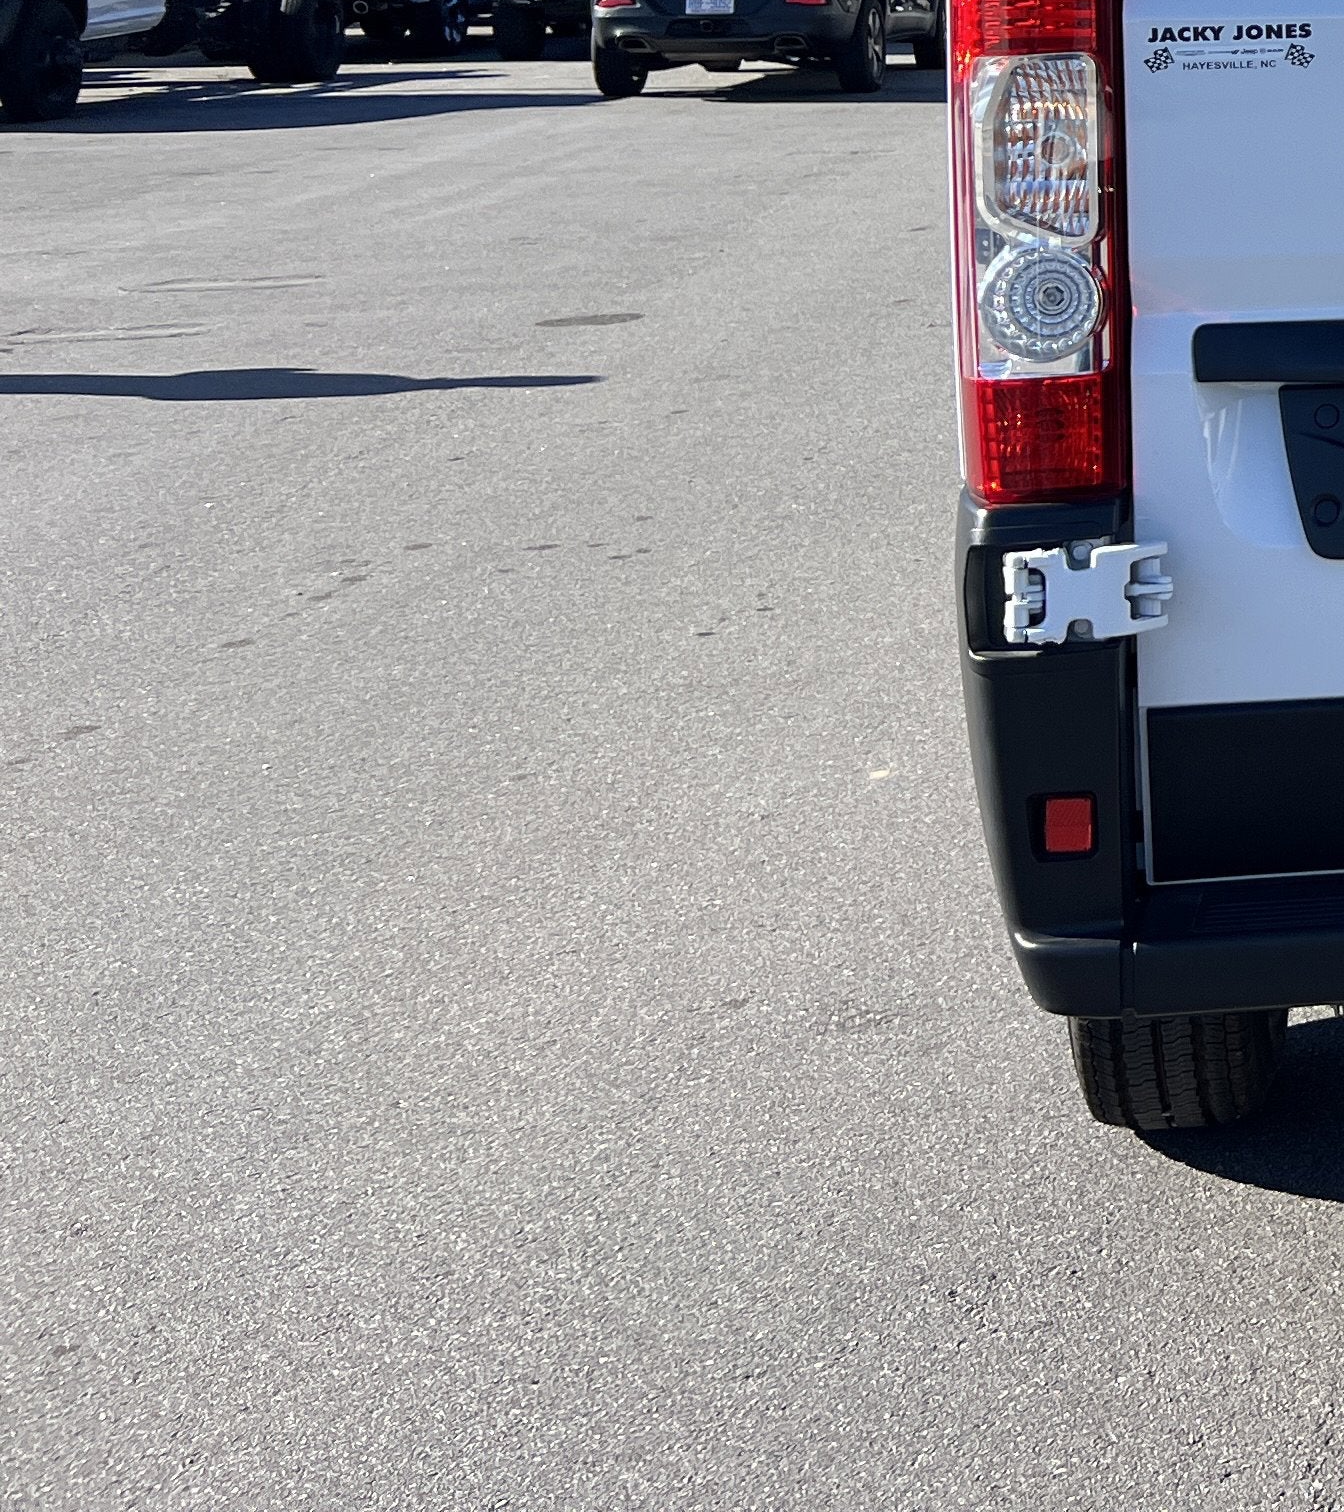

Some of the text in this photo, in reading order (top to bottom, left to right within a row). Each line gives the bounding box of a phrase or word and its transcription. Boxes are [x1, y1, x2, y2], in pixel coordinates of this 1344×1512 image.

[1147, 23, 1312, 43] JACKY JONES
[1182, 60, 1277, 70] HAYESVILLE, NC
